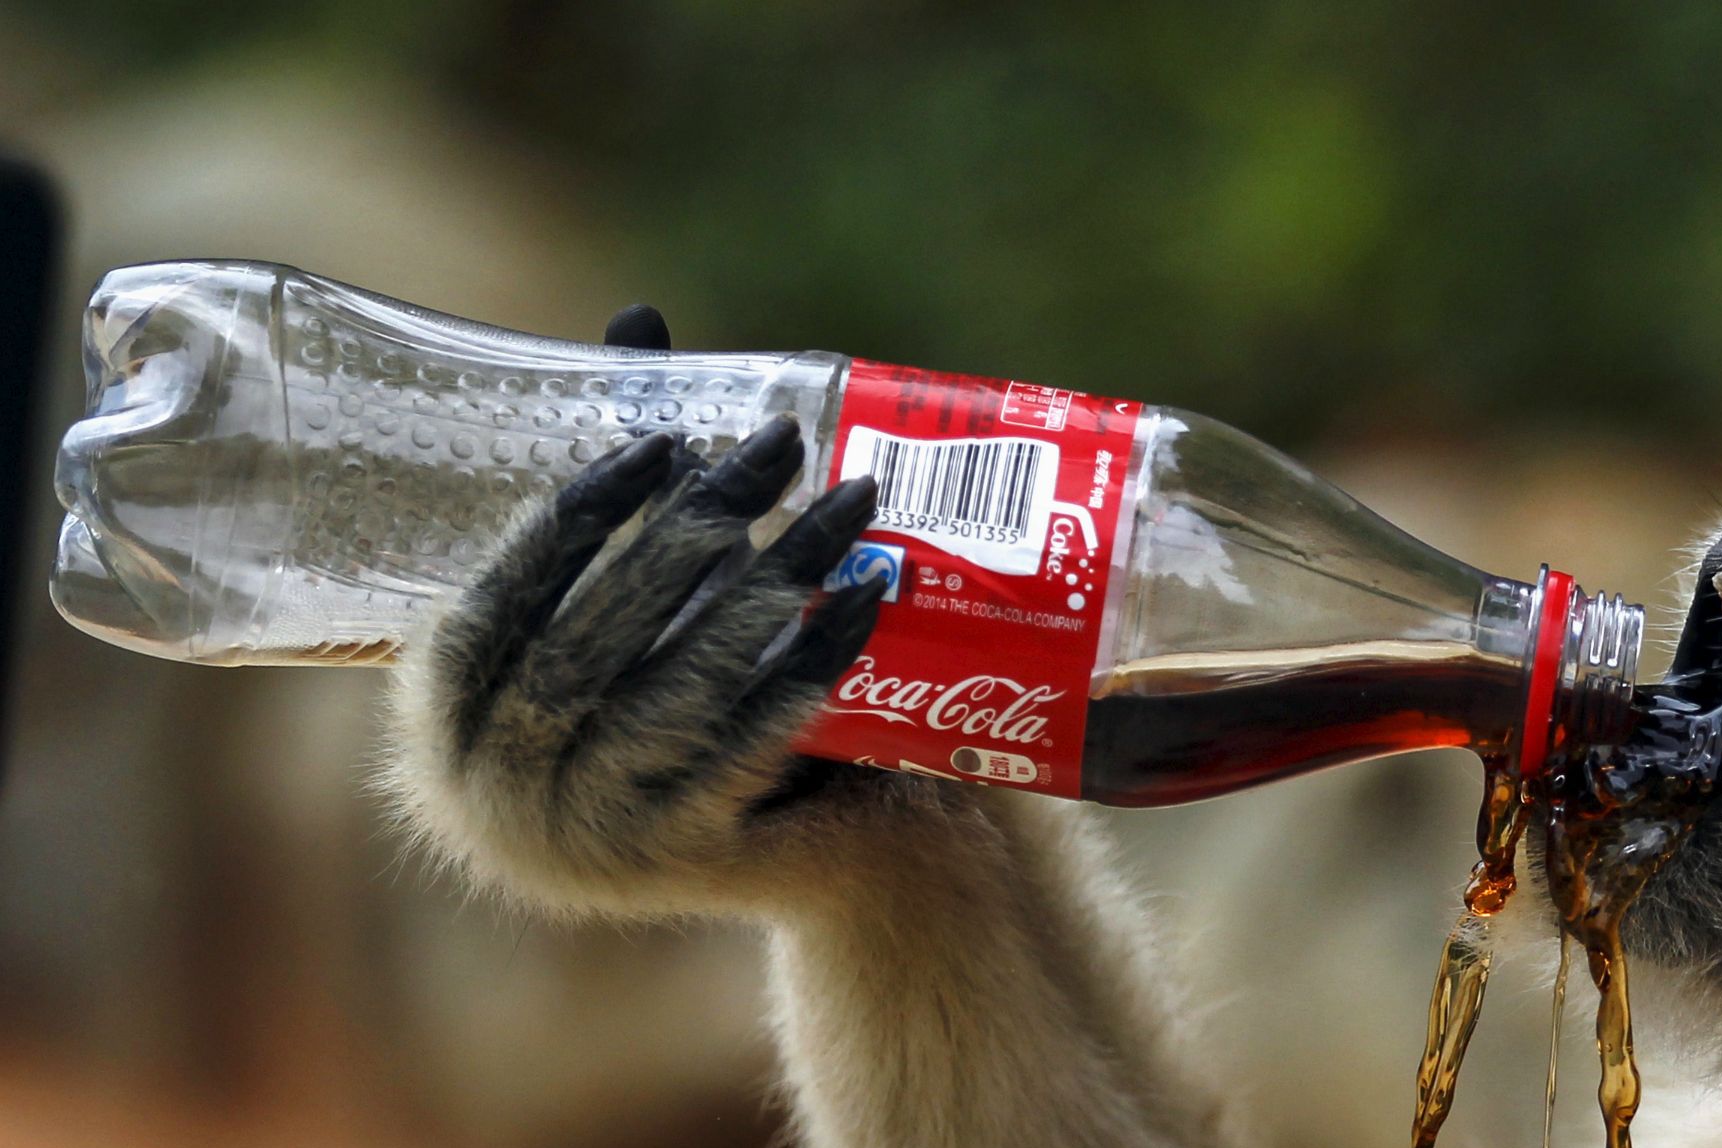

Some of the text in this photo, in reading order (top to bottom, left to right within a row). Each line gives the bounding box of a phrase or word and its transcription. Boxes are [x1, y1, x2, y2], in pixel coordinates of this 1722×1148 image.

[949, 520, 1020, 544] 501355
[1047, 517, 1074, 574] Coke
[949, 598, 970, 616] THE
[971, 601, 1032, 625] COCA-COLA
[1033, 612, 1086, 633] COMPANY
